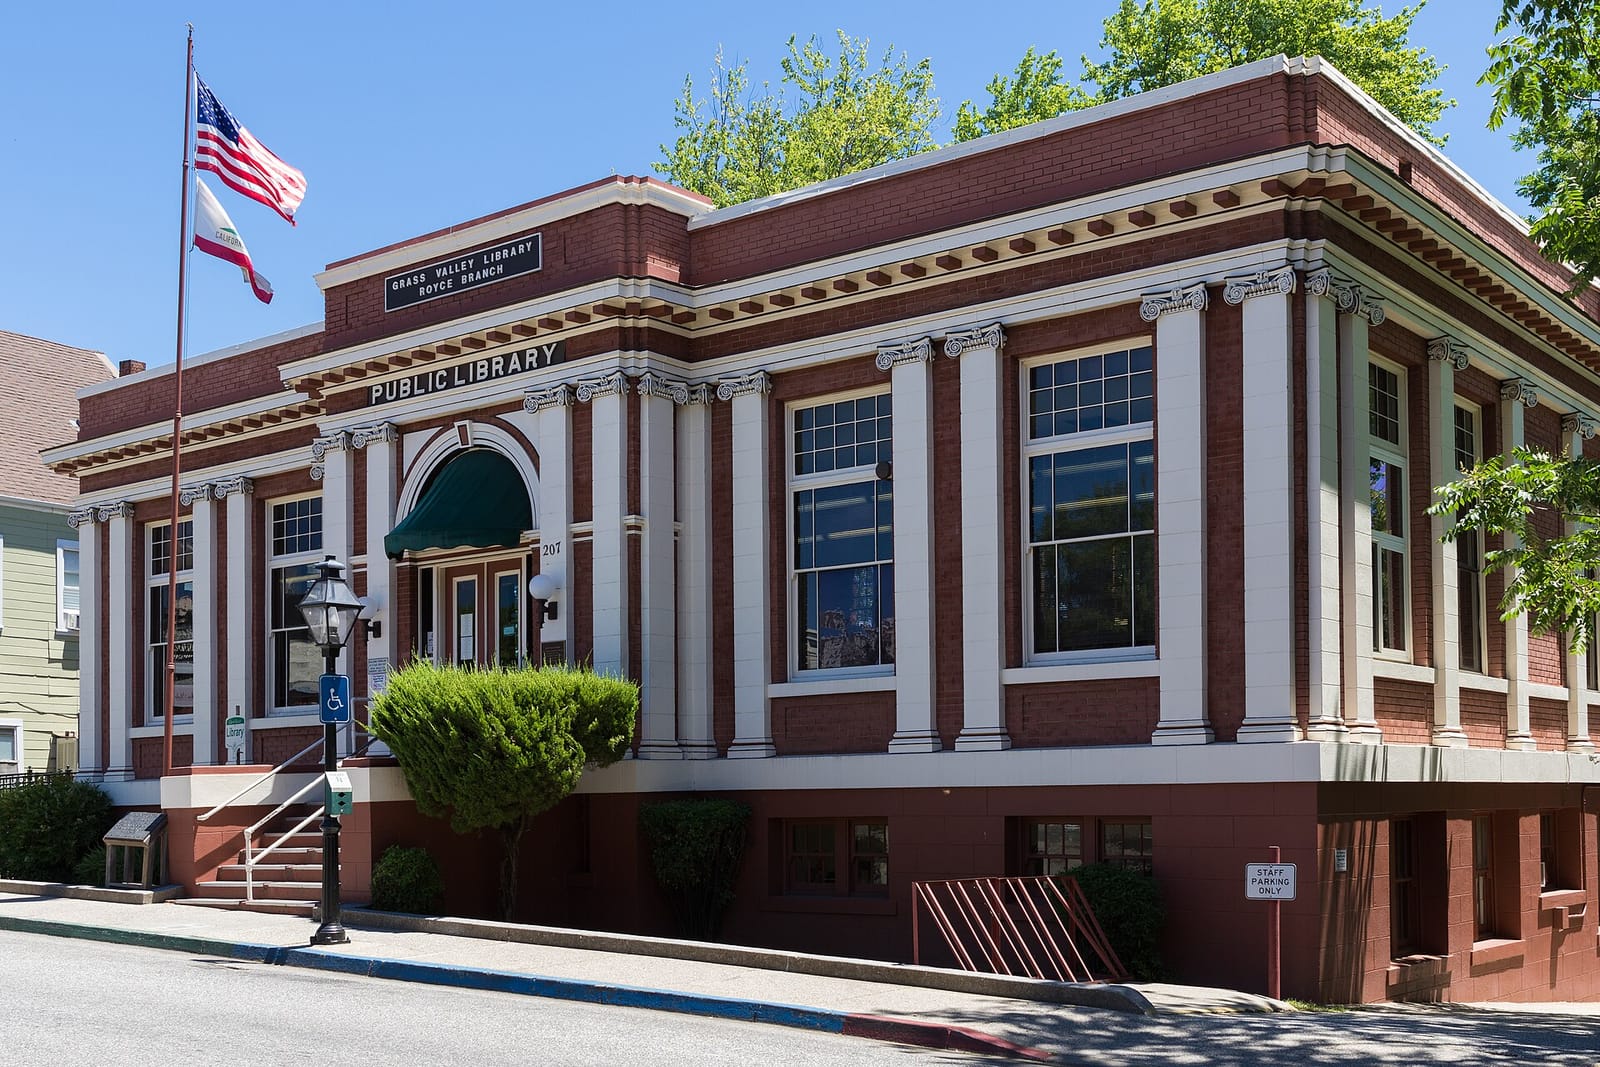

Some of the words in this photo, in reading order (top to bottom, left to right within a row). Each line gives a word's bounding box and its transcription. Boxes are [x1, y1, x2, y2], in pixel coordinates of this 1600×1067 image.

[392, 273, 426, 291] GRASS
[435, 258, 475, 278] VALLEY
[483, 241, 533, 264] LIBRARY
[419, 279, 453, 297] ROYCE
[461, 264, 504, 285] BRANCH
[371, 369, 448, 405] PUBLIC
[454, 343, 558, 386] LIBRARY
[542, 541, 562, 556] 207
[226, 727, 244, 738] Library
[1257, 869, 1285, 877] STAFF
[1251, 878, 1290, 886] PARKING
[1258, 887, 1282, 895] ONLY
